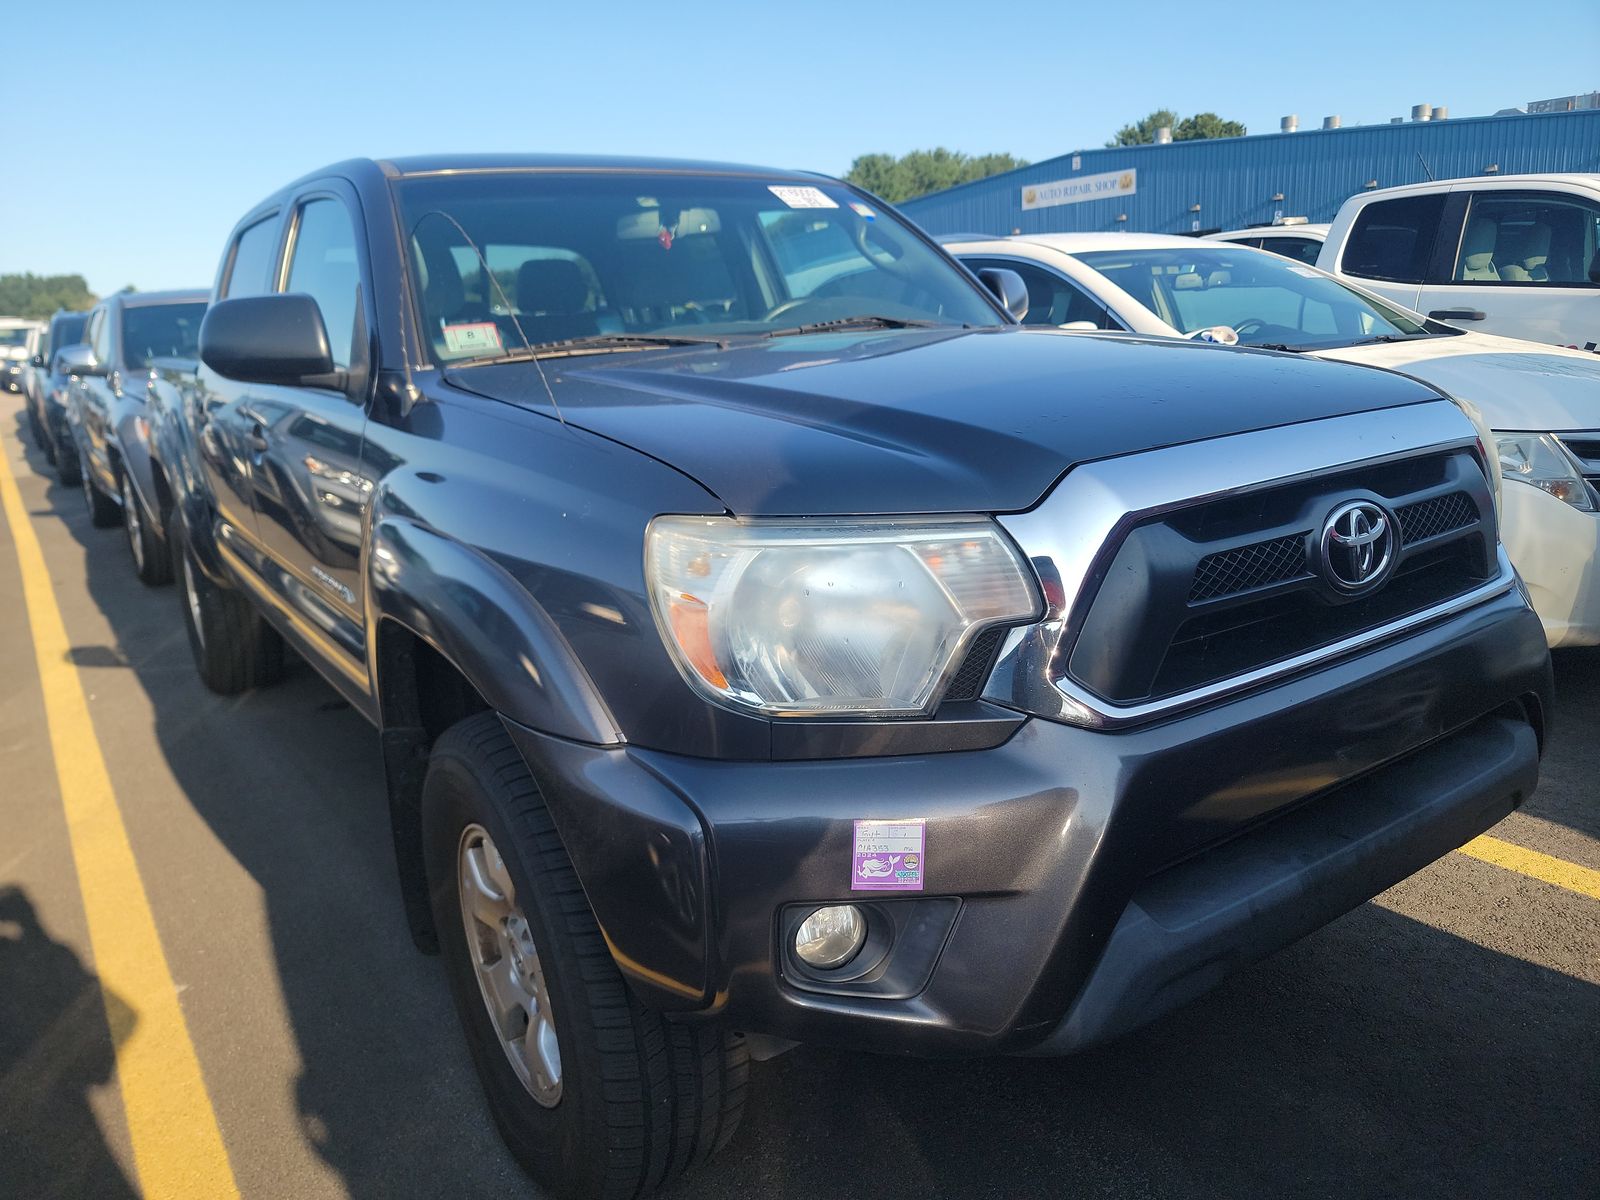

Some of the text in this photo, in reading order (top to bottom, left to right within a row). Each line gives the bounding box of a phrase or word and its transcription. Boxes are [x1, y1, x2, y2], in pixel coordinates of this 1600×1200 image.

[1040, 179, 1117, 200] AUTO REPAIR SHOP
